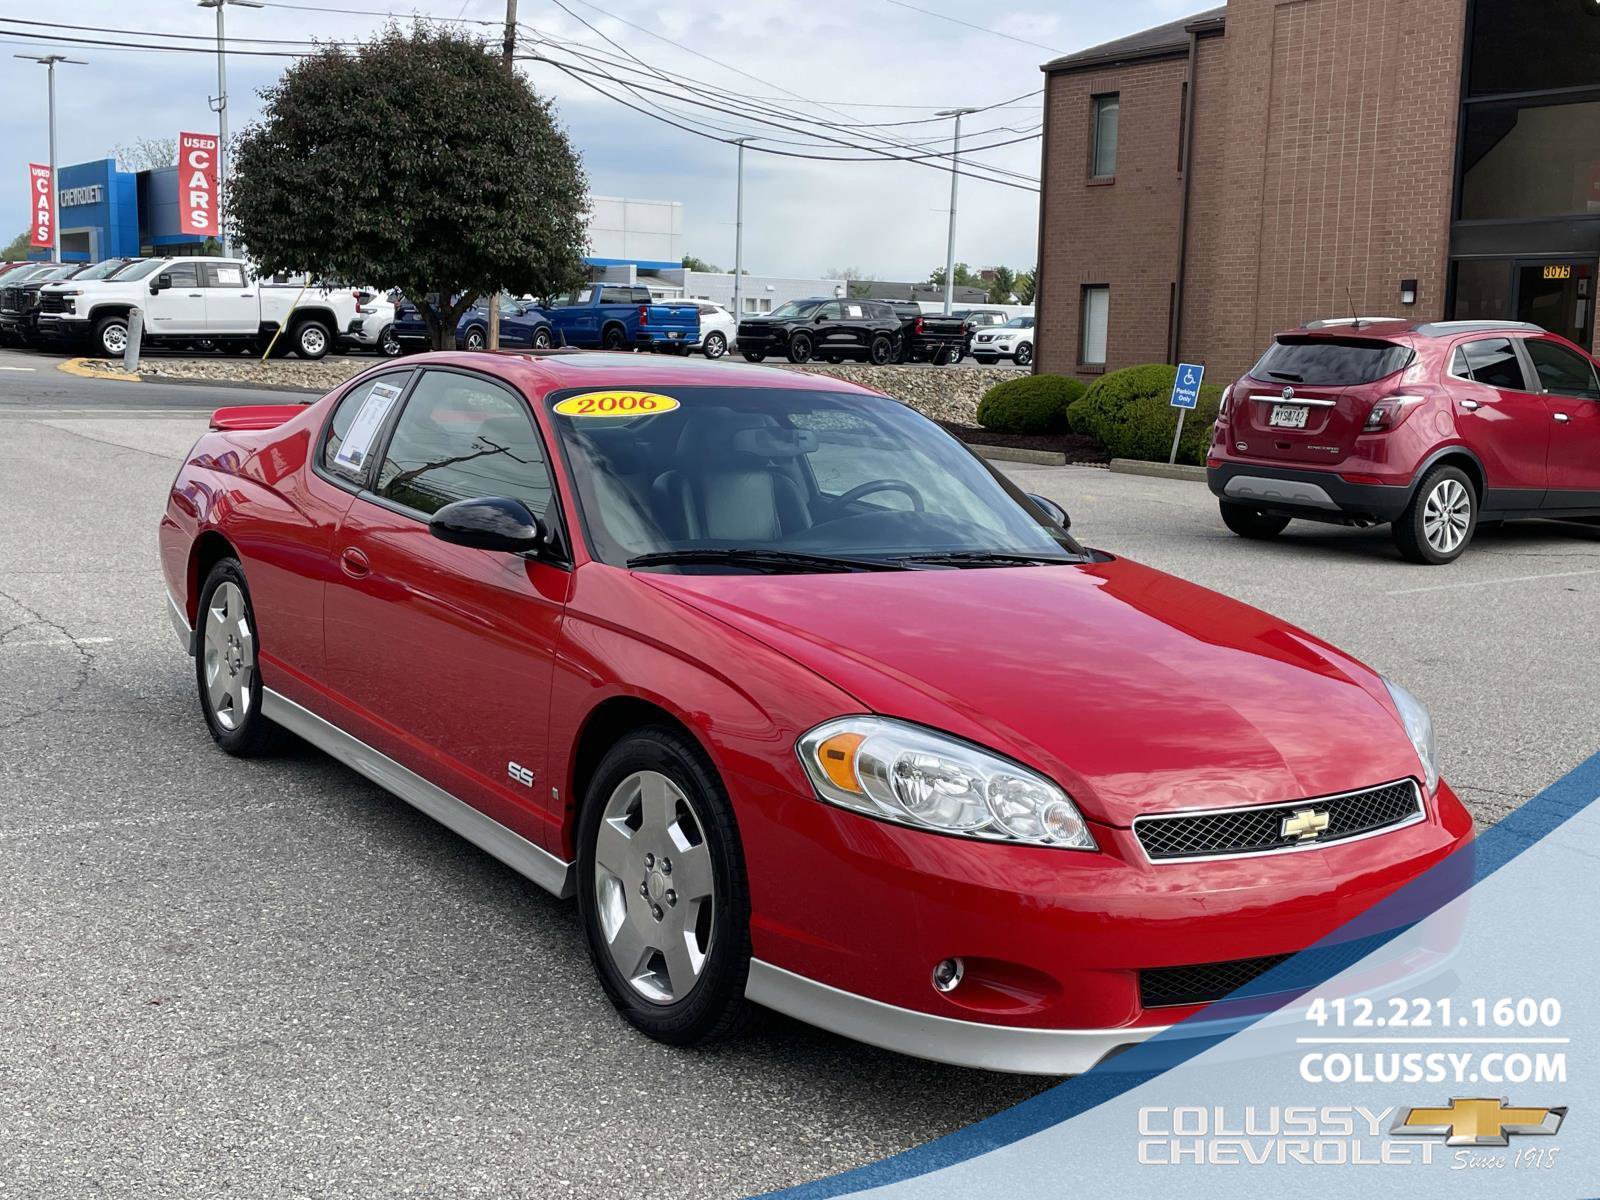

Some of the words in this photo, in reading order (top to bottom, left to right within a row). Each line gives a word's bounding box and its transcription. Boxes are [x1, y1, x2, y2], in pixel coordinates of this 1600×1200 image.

[183, 138, 216, 149] USED
[32, 168, 50, 177] USED
[60, 185, 104, 207] CHEVROLET
[188, 150, 210, 228] CARS
[36, 178, 50, 241] CARS
[1544, 265, 1570, 278] 3075
[1176, 388, 1196, 397] Parking
[1178, 395, 1191, 403] Only
[577, 396, 657, 413] 2006
[508, 761, 535, 788] SS
